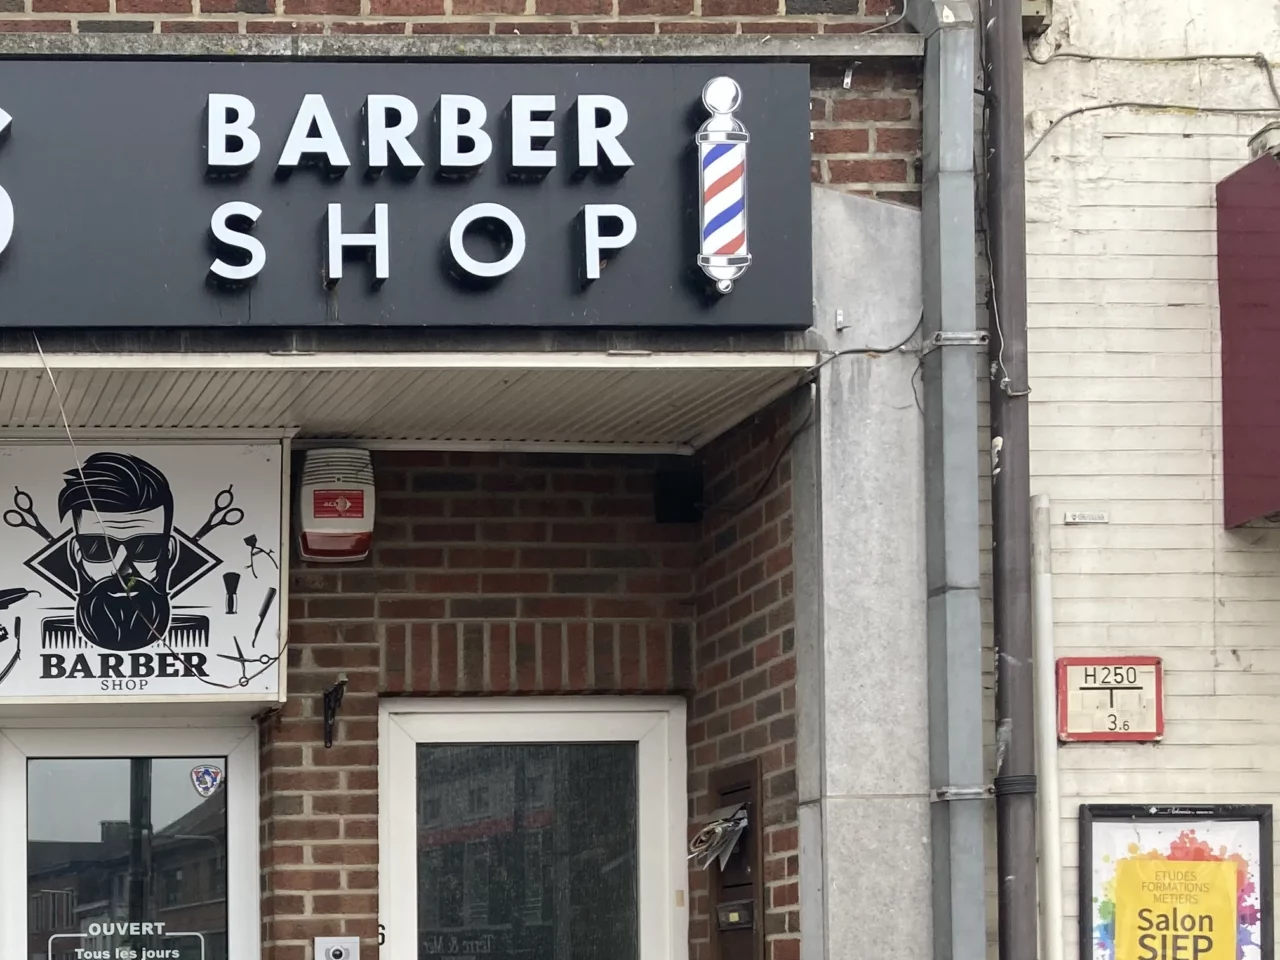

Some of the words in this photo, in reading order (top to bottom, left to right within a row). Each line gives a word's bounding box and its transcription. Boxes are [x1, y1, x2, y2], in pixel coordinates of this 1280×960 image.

[206, 92, 635, 168] BARBER
[208, 200, 638, 281] SHOP
[39, 653, 210, 679] BARBER
[1084, 666, 1137, 684] H250
[100, 679, 149, 691] SHOP
[1107, 713, 1130, 731] 3.6
[1154, 870, 1198, 882] ETUDES
[1141, 881, 1210, 893] FORMATIONS
[1153, 893, 1199, 905] METIERS
[1137, 907, 1214, 932] Salon
[88, 922, 166, 936] OUVERT
[74, 948, 111, 959] Tous
[115, 947, 137, 959] les
[141, 947, 180, 960] jours
